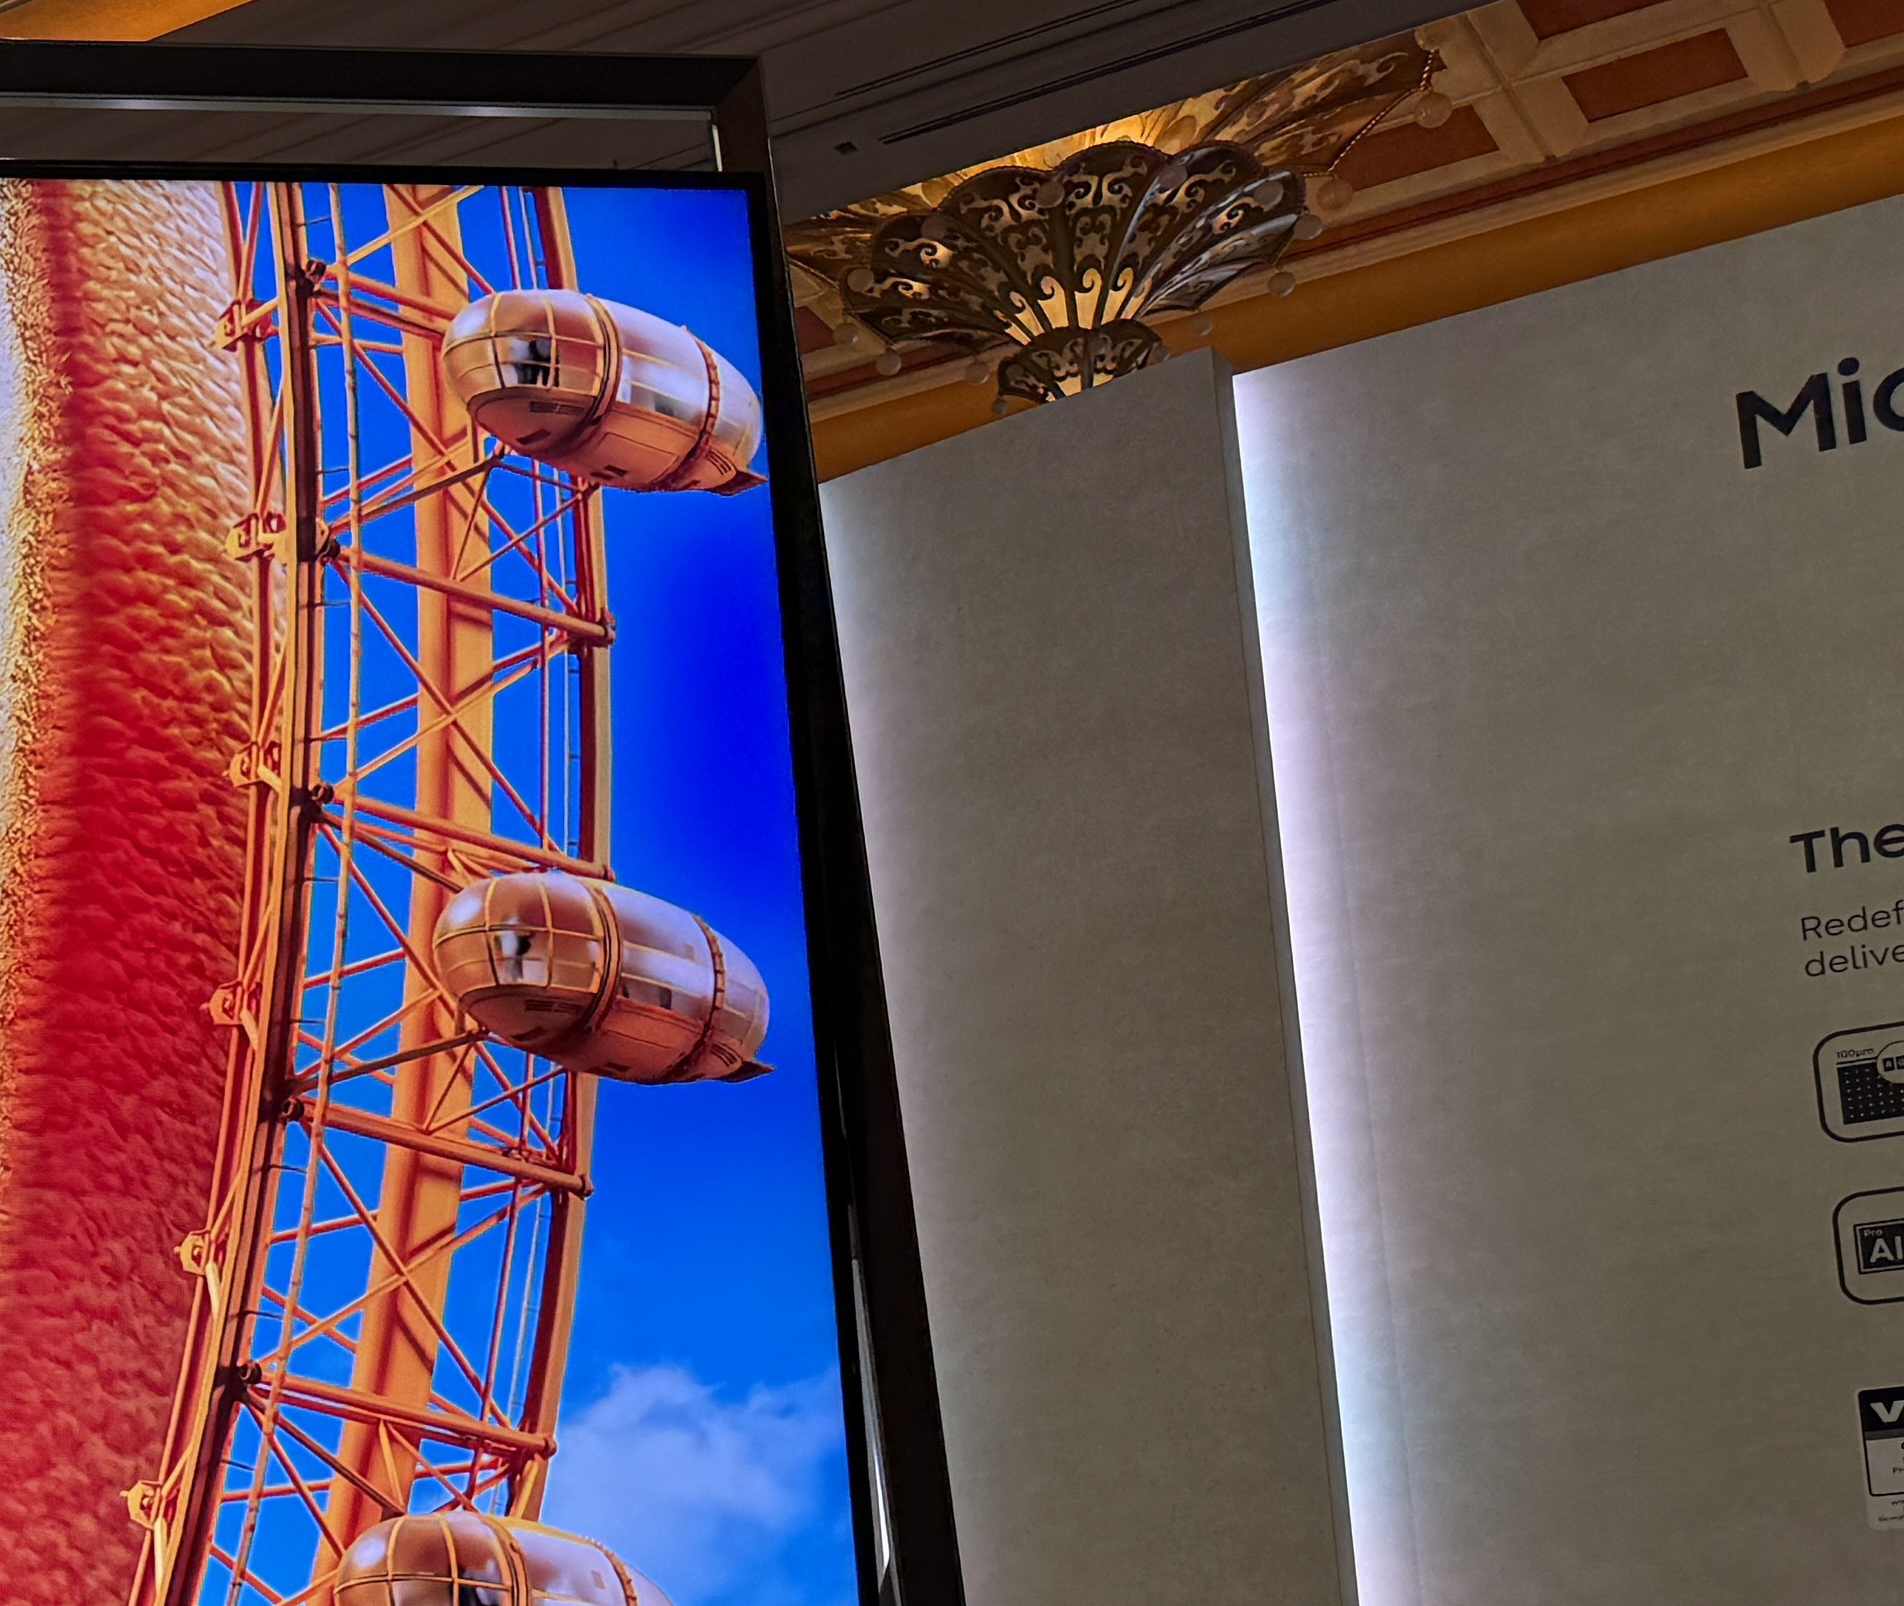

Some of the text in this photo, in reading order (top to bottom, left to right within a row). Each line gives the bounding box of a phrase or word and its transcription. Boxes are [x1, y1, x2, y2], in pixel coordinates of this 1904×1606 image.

[1789, 824, 1904, 873] The
[1801, 899, 1904, 941] Redef
[1870, 1236, 1903, 1263] AI
